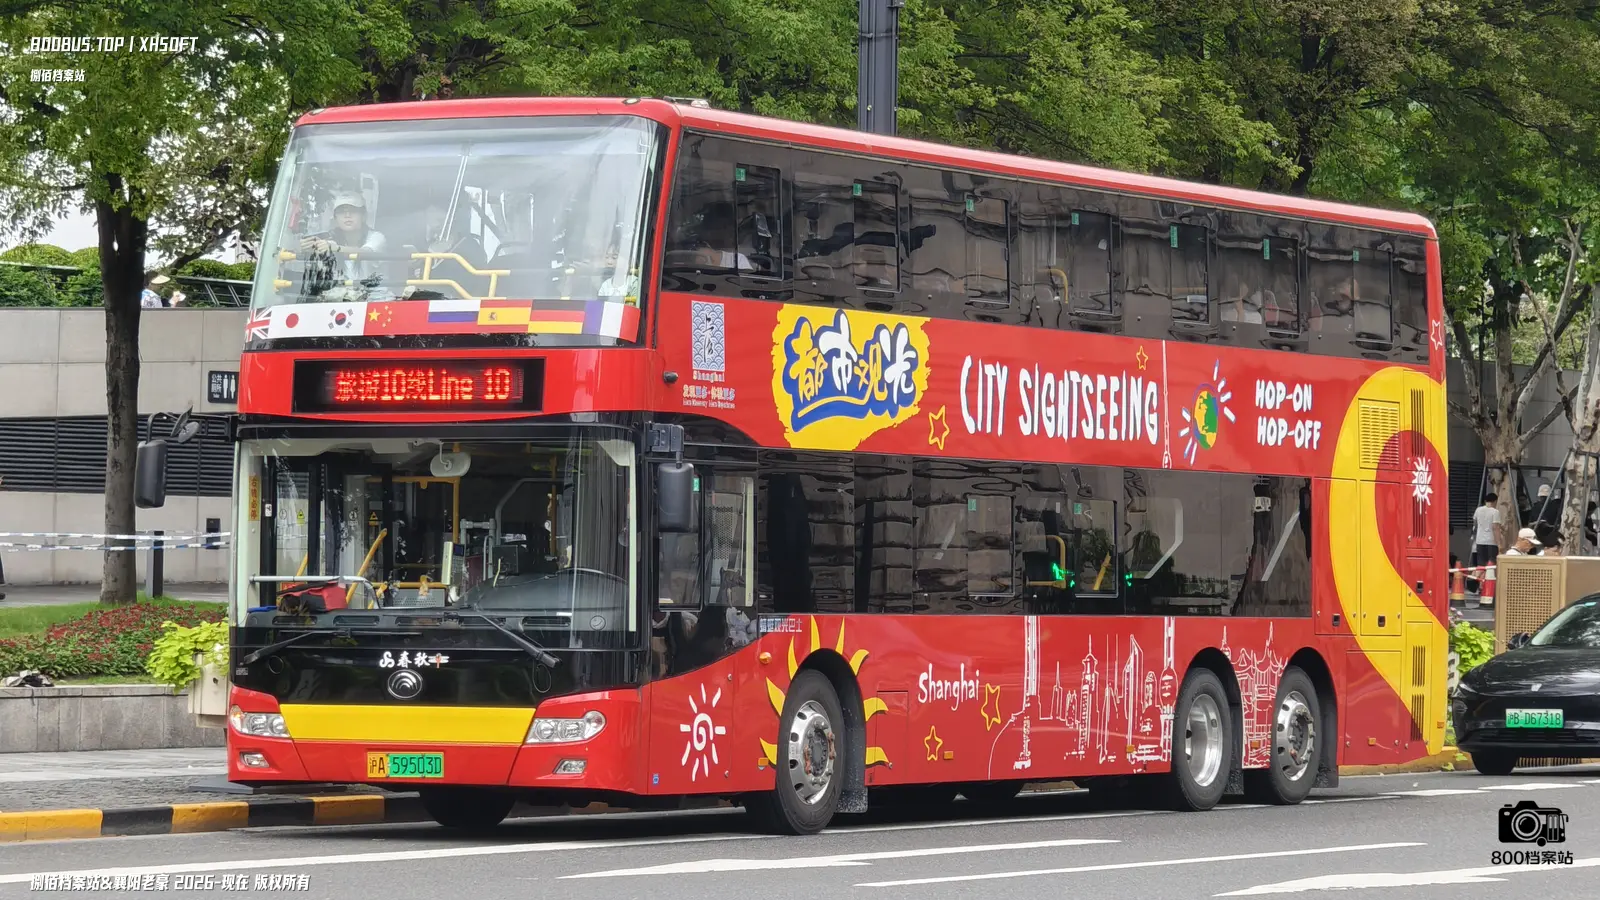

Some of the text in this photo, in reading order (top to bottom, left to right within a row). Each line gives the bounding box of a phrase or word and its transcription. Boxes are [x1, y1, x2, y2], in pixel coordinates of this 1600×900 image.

[786, 310, 918, 408] 都市观光
[483, 368, 512, 401] 10
[959, 355, 1159, 446] CITY SIGHTSEEING
[1255, 379, 1313, 412] HOP-ON
[1256, 416, 1322, 450] HOP-OFF
[397, 650, 431, 669] 春秋
[918, 662, 980, 711] Shanghai
